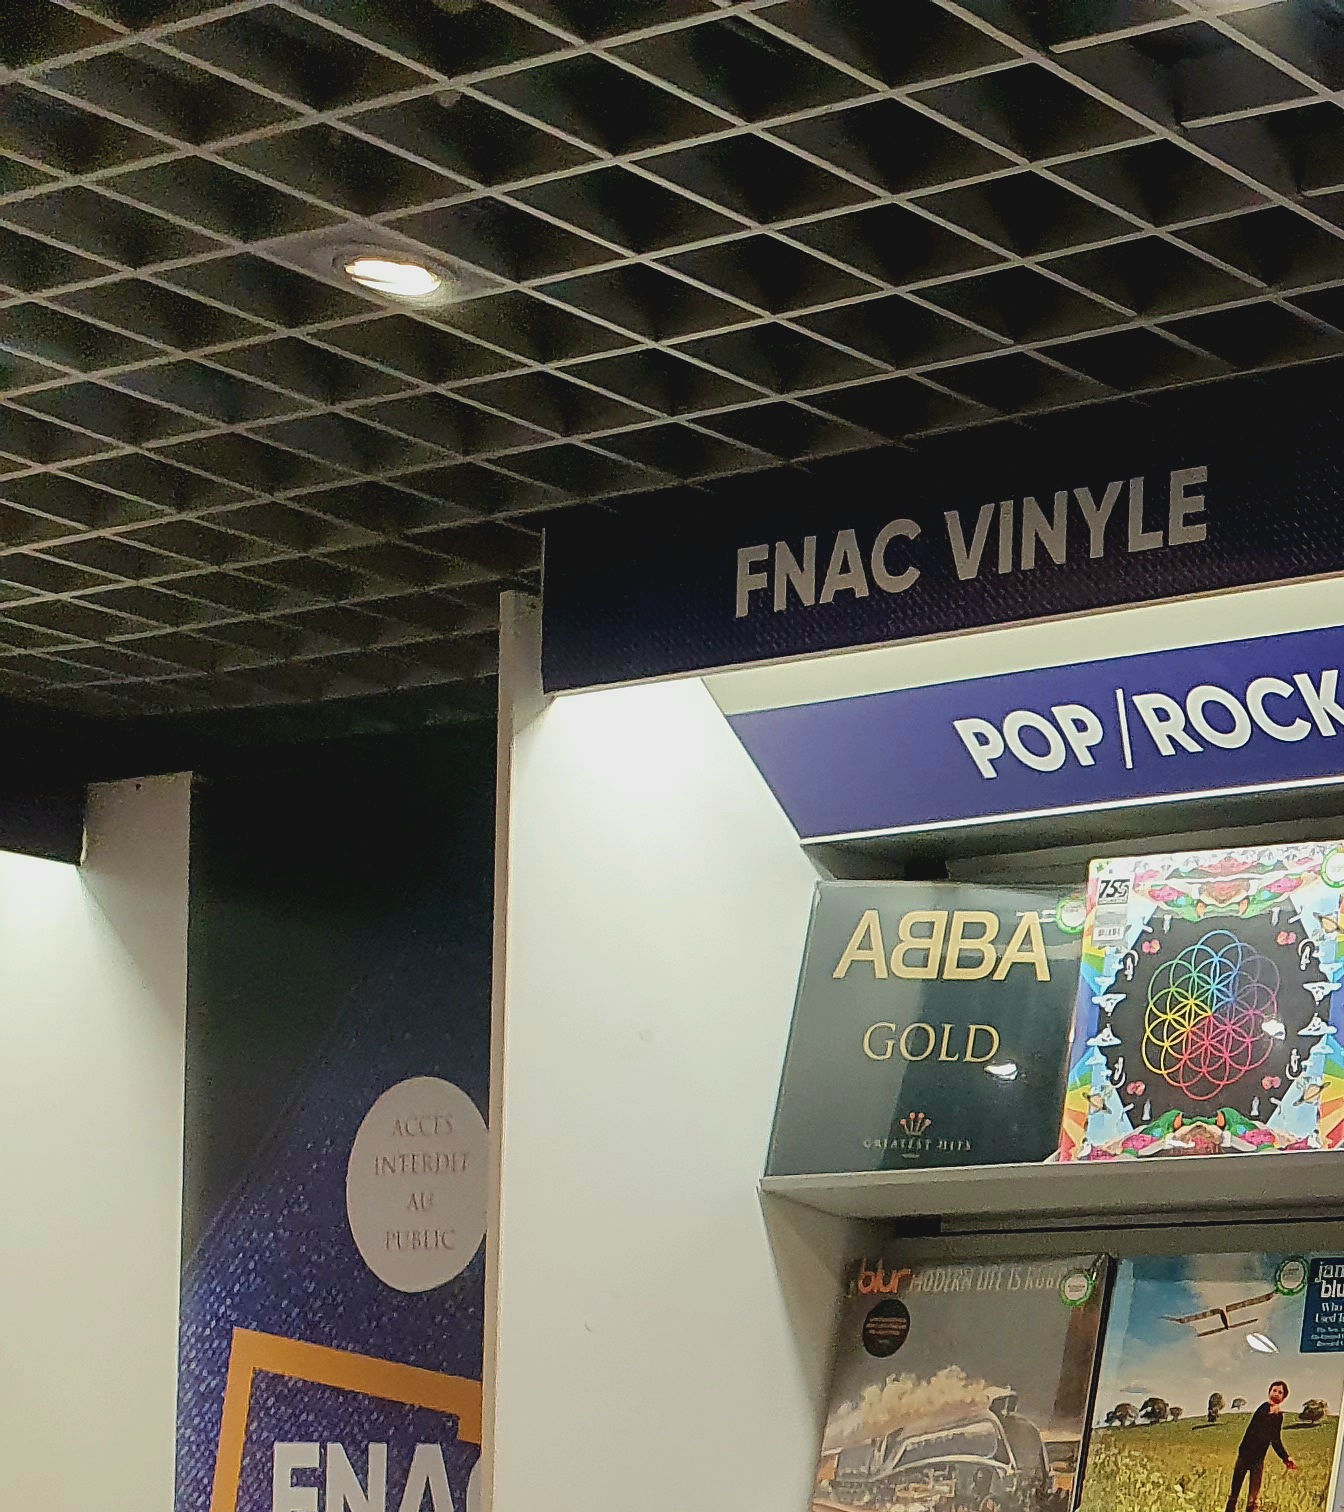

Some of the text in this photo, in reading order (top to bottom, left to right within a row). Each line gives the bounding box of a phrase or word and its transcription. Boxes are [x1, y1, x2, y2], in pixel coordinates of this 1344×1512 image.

[735, 465, 1208, 617] FNAC VINYLE
[832, 909, 1051, 982] ABBA
[862, 1022, 1000, 1063] GOLD
[374, 1150, 470, 1176] INTERDIT
[384, 1229, 455, 1251] PUBLIC
[858, 1258, 912, 1294] blur
